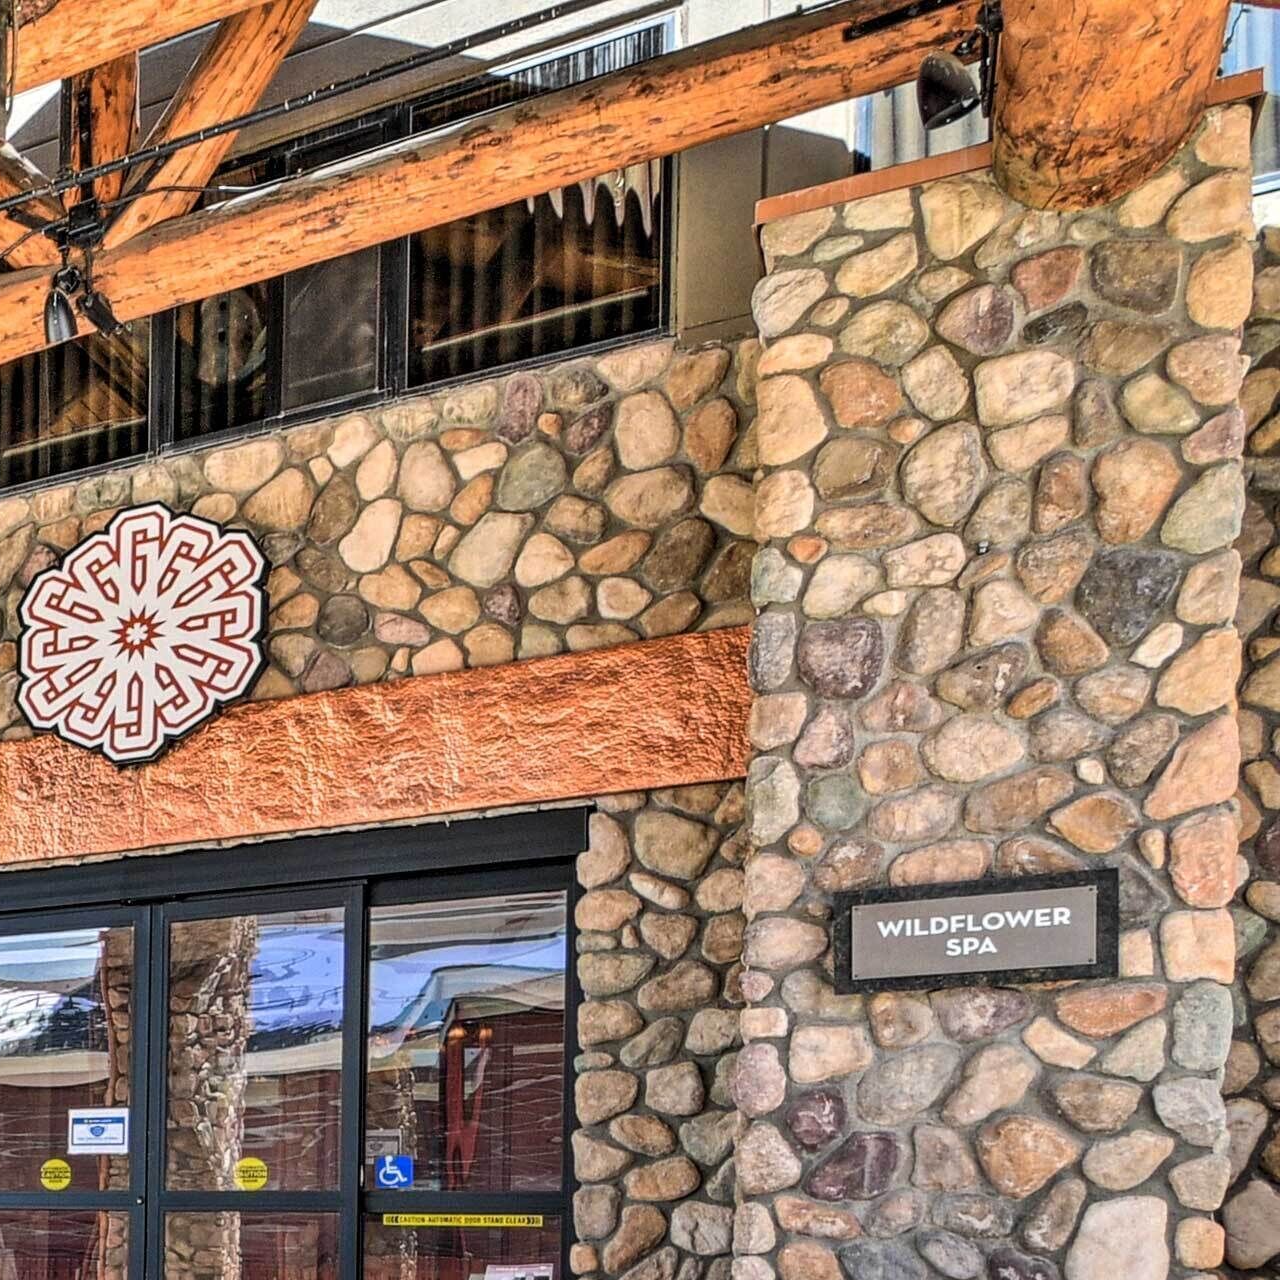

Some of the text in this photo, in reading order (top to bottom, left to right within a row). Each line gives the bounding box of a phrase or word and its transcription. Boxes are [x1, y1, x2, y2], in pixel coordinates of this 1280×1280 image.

[877, 907, 1071, 938] WILDFLOWER
[945, 937, 998, 957] SPA
[399, 1215, 425, 1224] CAUTION
[428, 1215, 464, 1224] AUTOMATIC
